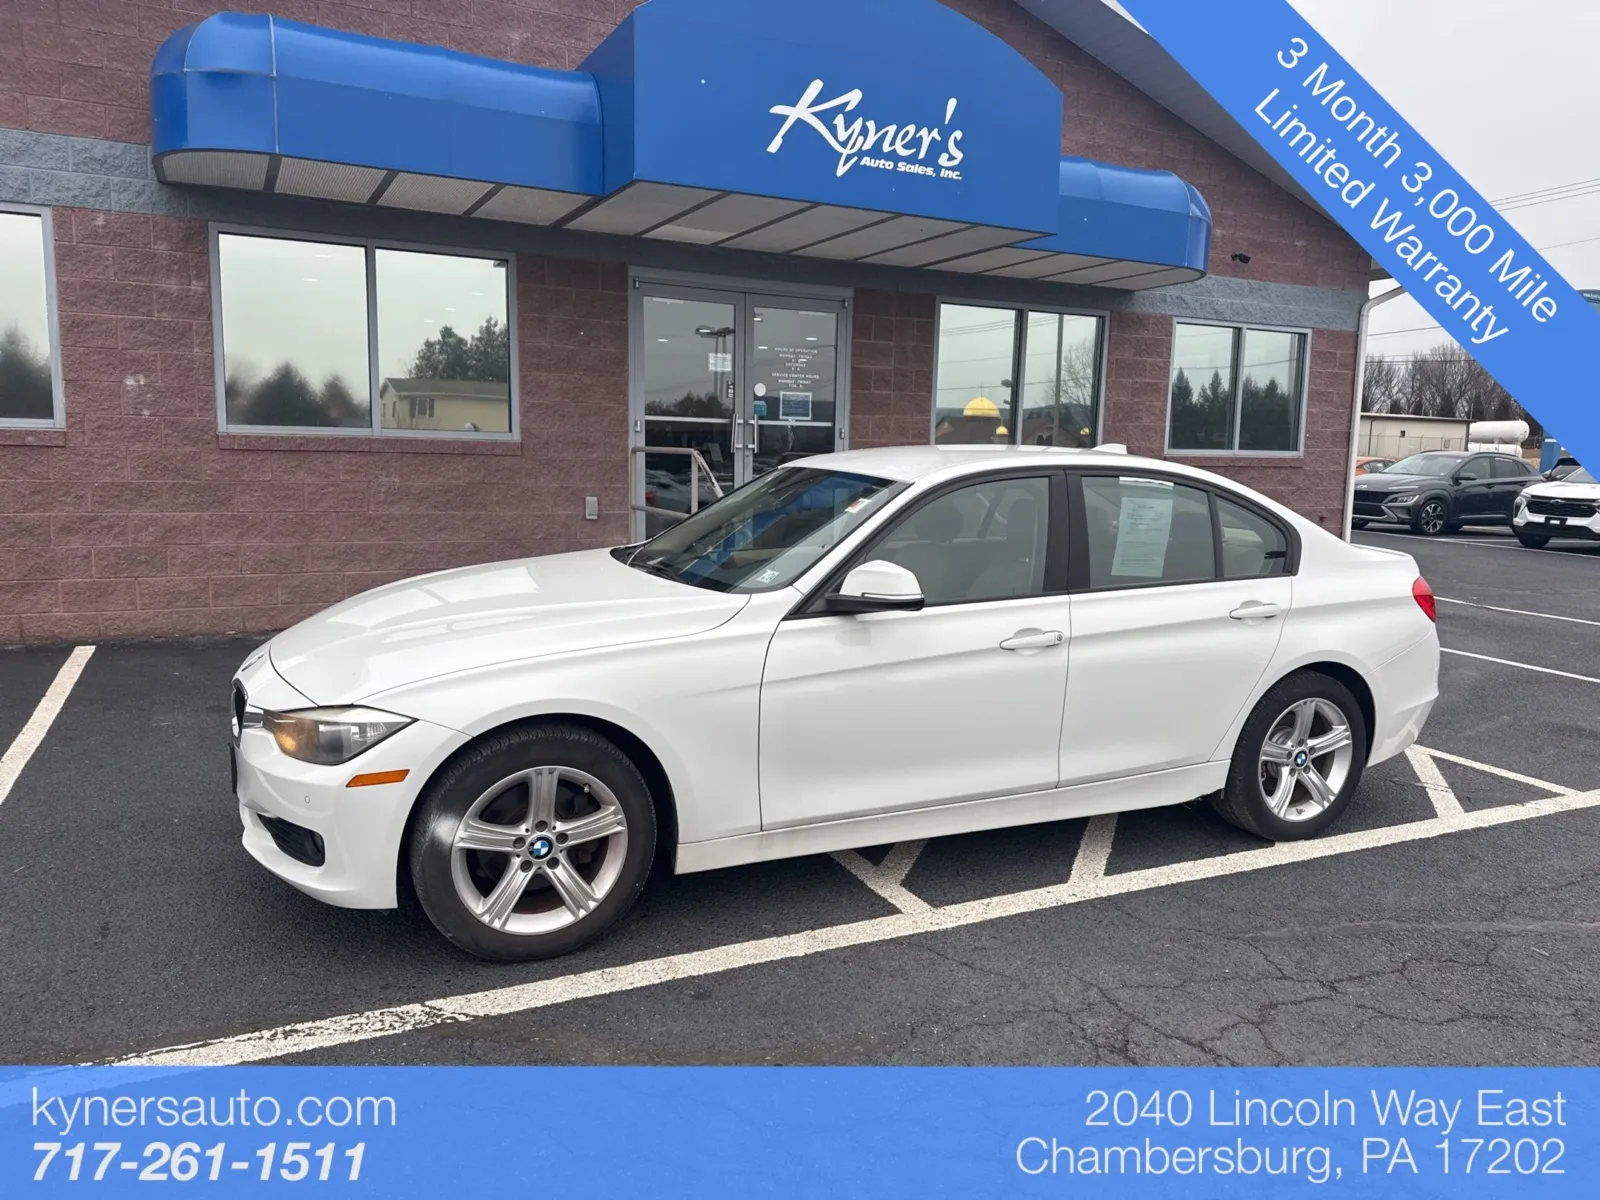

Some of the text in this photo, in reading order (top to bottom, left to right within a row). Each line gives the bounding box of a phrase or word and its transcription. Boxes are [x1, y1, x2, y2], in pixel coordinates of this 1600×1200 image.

[766, 78, 964, 178] Kyner's
[860, 156, 963, 180] Auto Sales, Inc.
